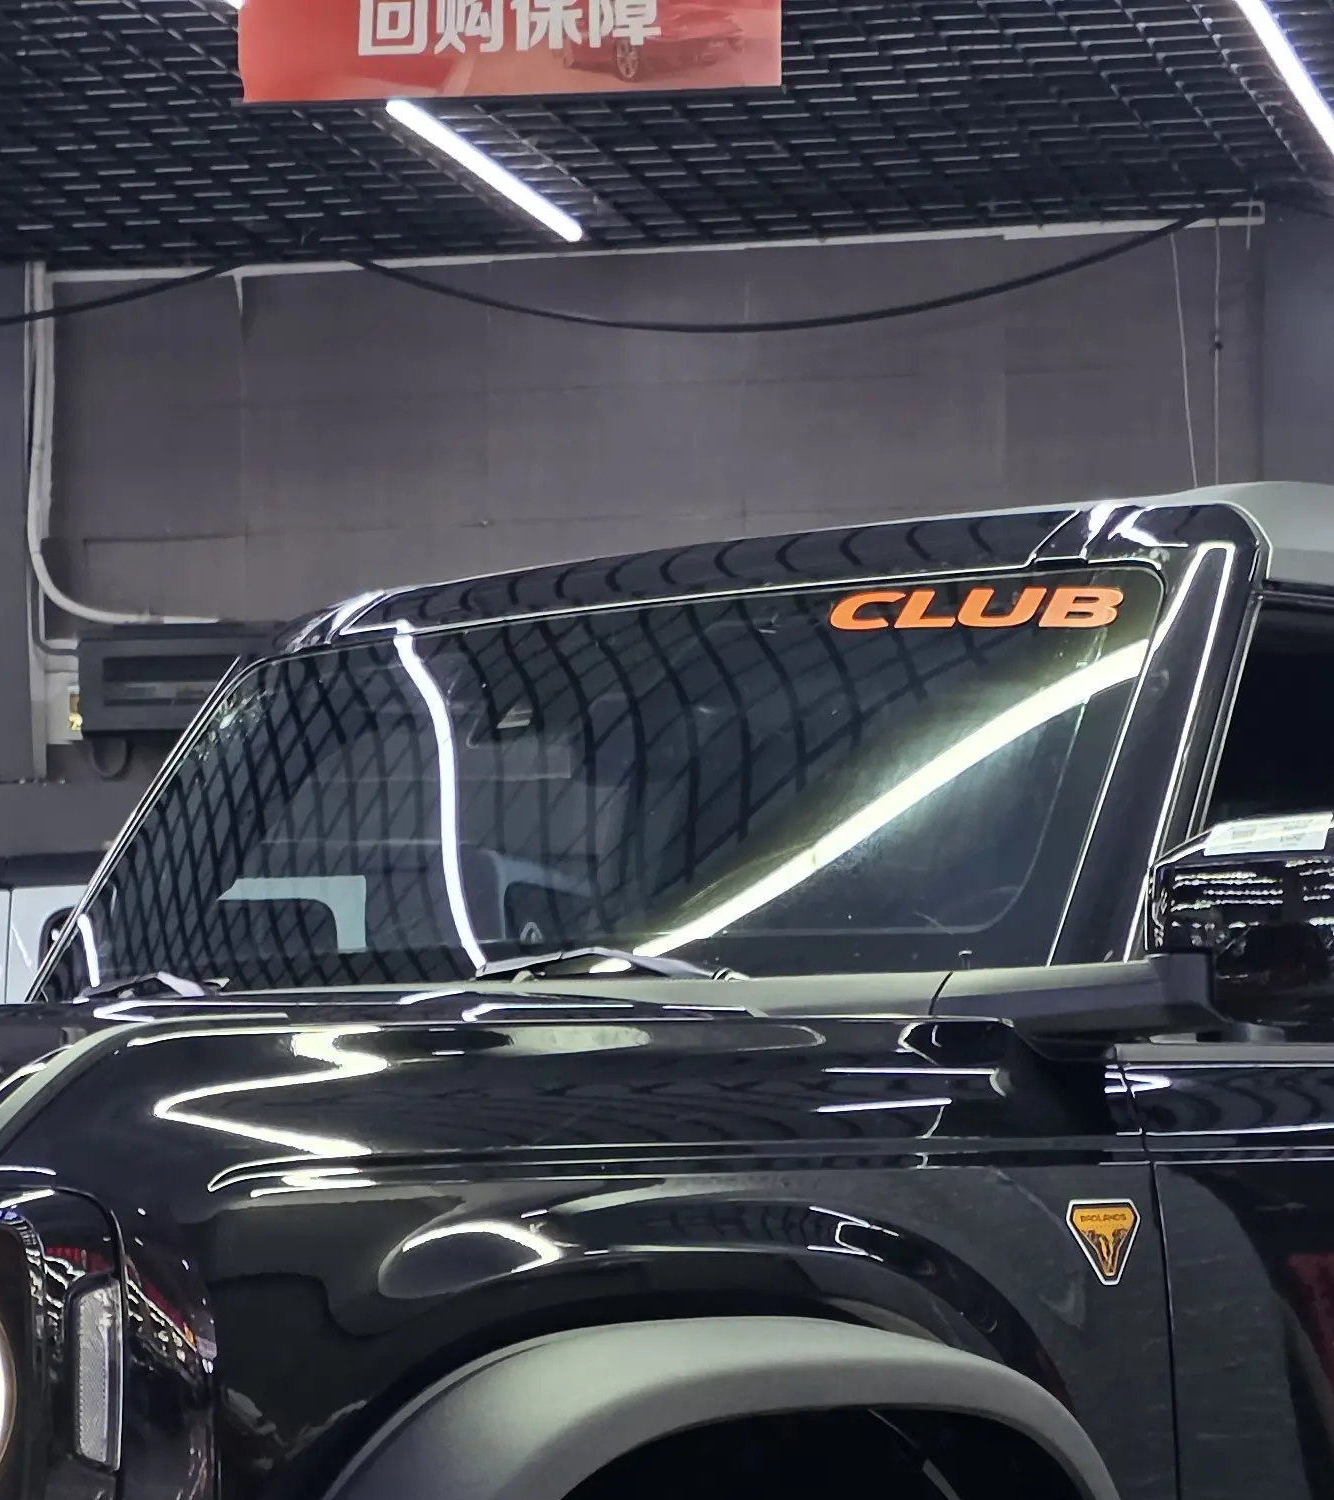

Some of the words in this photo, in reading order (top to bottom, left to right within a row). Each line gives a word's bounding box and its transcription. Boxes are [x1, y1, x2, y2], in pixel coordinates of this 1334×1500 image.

[358, 0, 662, 56] 回购保障
[829, 586, 1124, 631] CLUB
